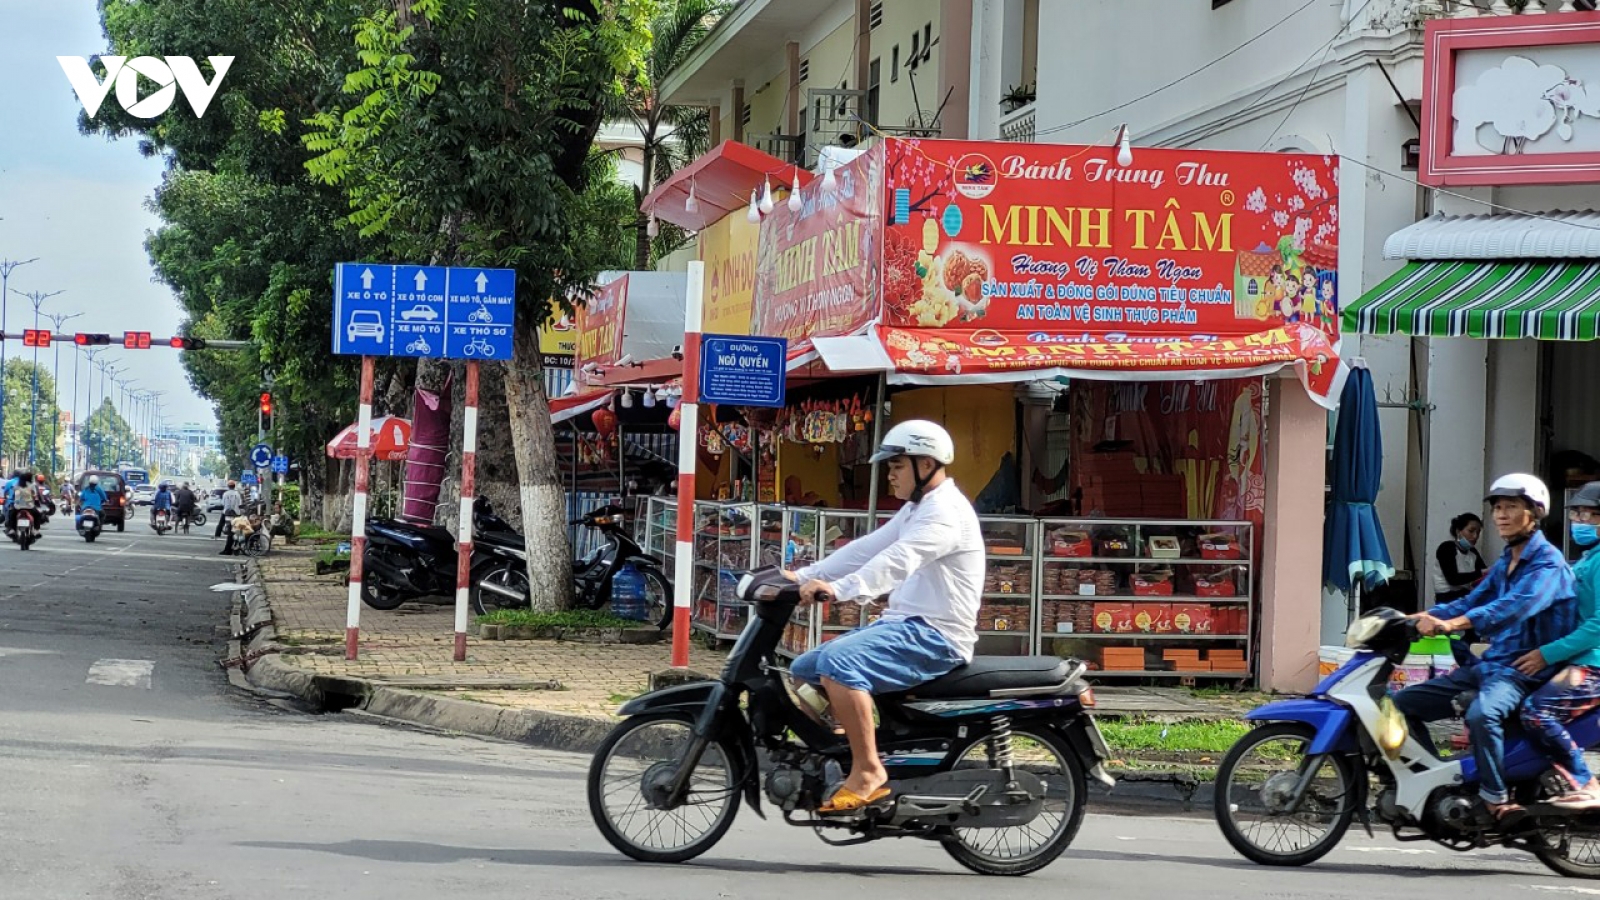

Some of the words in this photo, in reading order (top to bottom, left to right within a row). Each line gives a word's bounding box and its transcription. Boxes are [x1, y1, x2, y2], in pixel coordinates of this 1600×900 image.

[1001, 155, 1073, 180] Bánh
[1083, 158, 1165, 189] Trung
[1175, 161, 1230, 186] Thu
[979, 204, 1113, 248] MINH
[1125, 197, 1235, 252] TÂM
[1011, 254, 1069, 280] Hương
[1075, 256, 1098, 280] Vị
[1103, 256, 1151, 278] Thơm
[1155, 259, 1202, 283] Ngon
[347, 292, 360, 300] XE
[364, 291, 370, 300] Ô
[374, 291, 387, 300] TÔ
[409, 293, 414, 301] Ô
[416, 293, 426, 301] TÔ
[428, 294, 443, 302] CON
[1010, 278, 1043, 298] XUẤT
[1057, 281, 1093, 300] ĐÓNG
[1096, 282, 1118, 301] GÓI
[1121, 283, 1157, 302] ĐÚNG
[1159, 284, 1186, 303] TIÊU
[1189, 282, 1232, 304] CHUẨN
[450, 295, 459, 303] XE
[1016, 304, 1035, 320] AN
[1037, 302, 1071, 320] TOÀN
[1074, 303, 1091, 324] VỆ
[1094, 305, 1122, 321] SINH
[1125, 306, 1159, 325] THỰC
[1161, 303, 1197, 324] PHẨM
[412, 324, 426, 333] MÔ
[429, 324, 441, 333] TÔ
[470, 326, 490, 335] THÔ
[24, 331, 50, 346] 22
[718, 353, 735, 366] NGÔ
